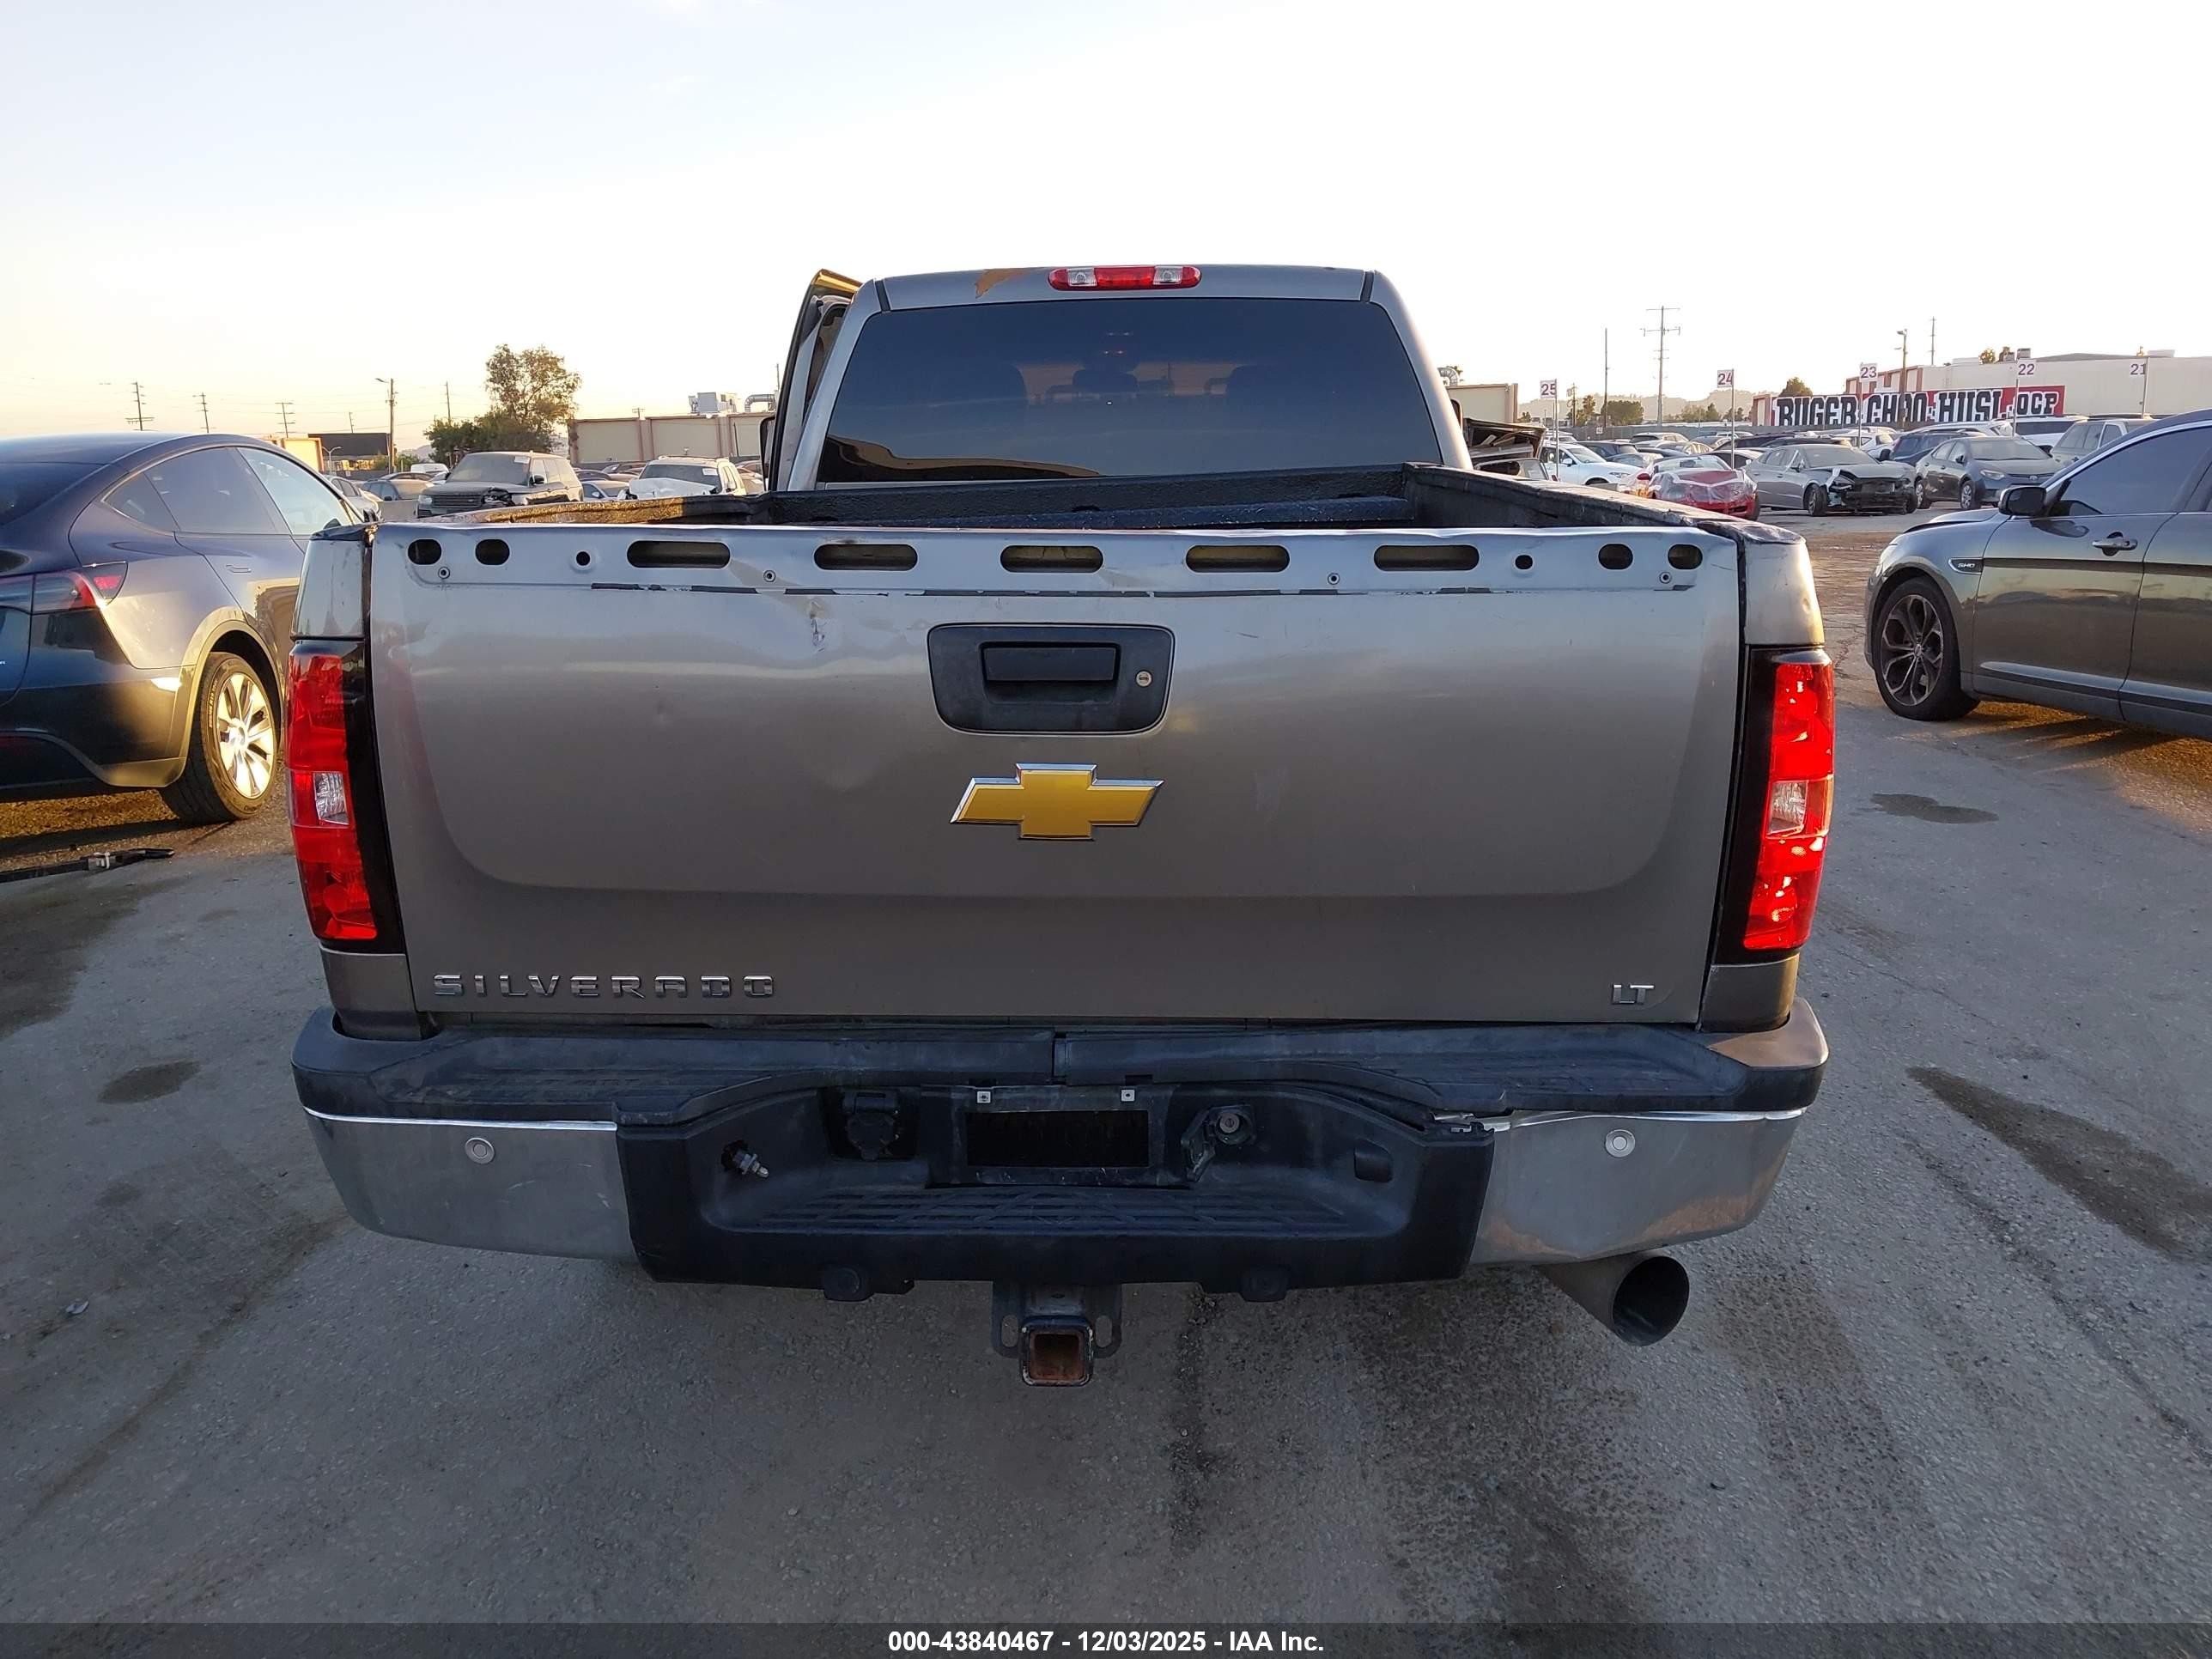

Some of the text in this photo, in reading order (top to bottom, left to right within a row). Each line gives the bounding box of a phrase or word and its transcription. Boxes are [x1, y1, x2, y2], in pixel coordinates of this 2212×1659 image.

[1860, 366, 1877, 379] 23
[2018, 363, 2035, 375] 22
[2130, 363, 2146, 375] 21
[1717, 372, 1733, 385] 24
[1540, 383, 1557, 396] 25
[2017, 392, 2057, 415] OCP
[433, 974, 775, 999] SILVERADO
[1612, 984, 1655, 1005] LT
